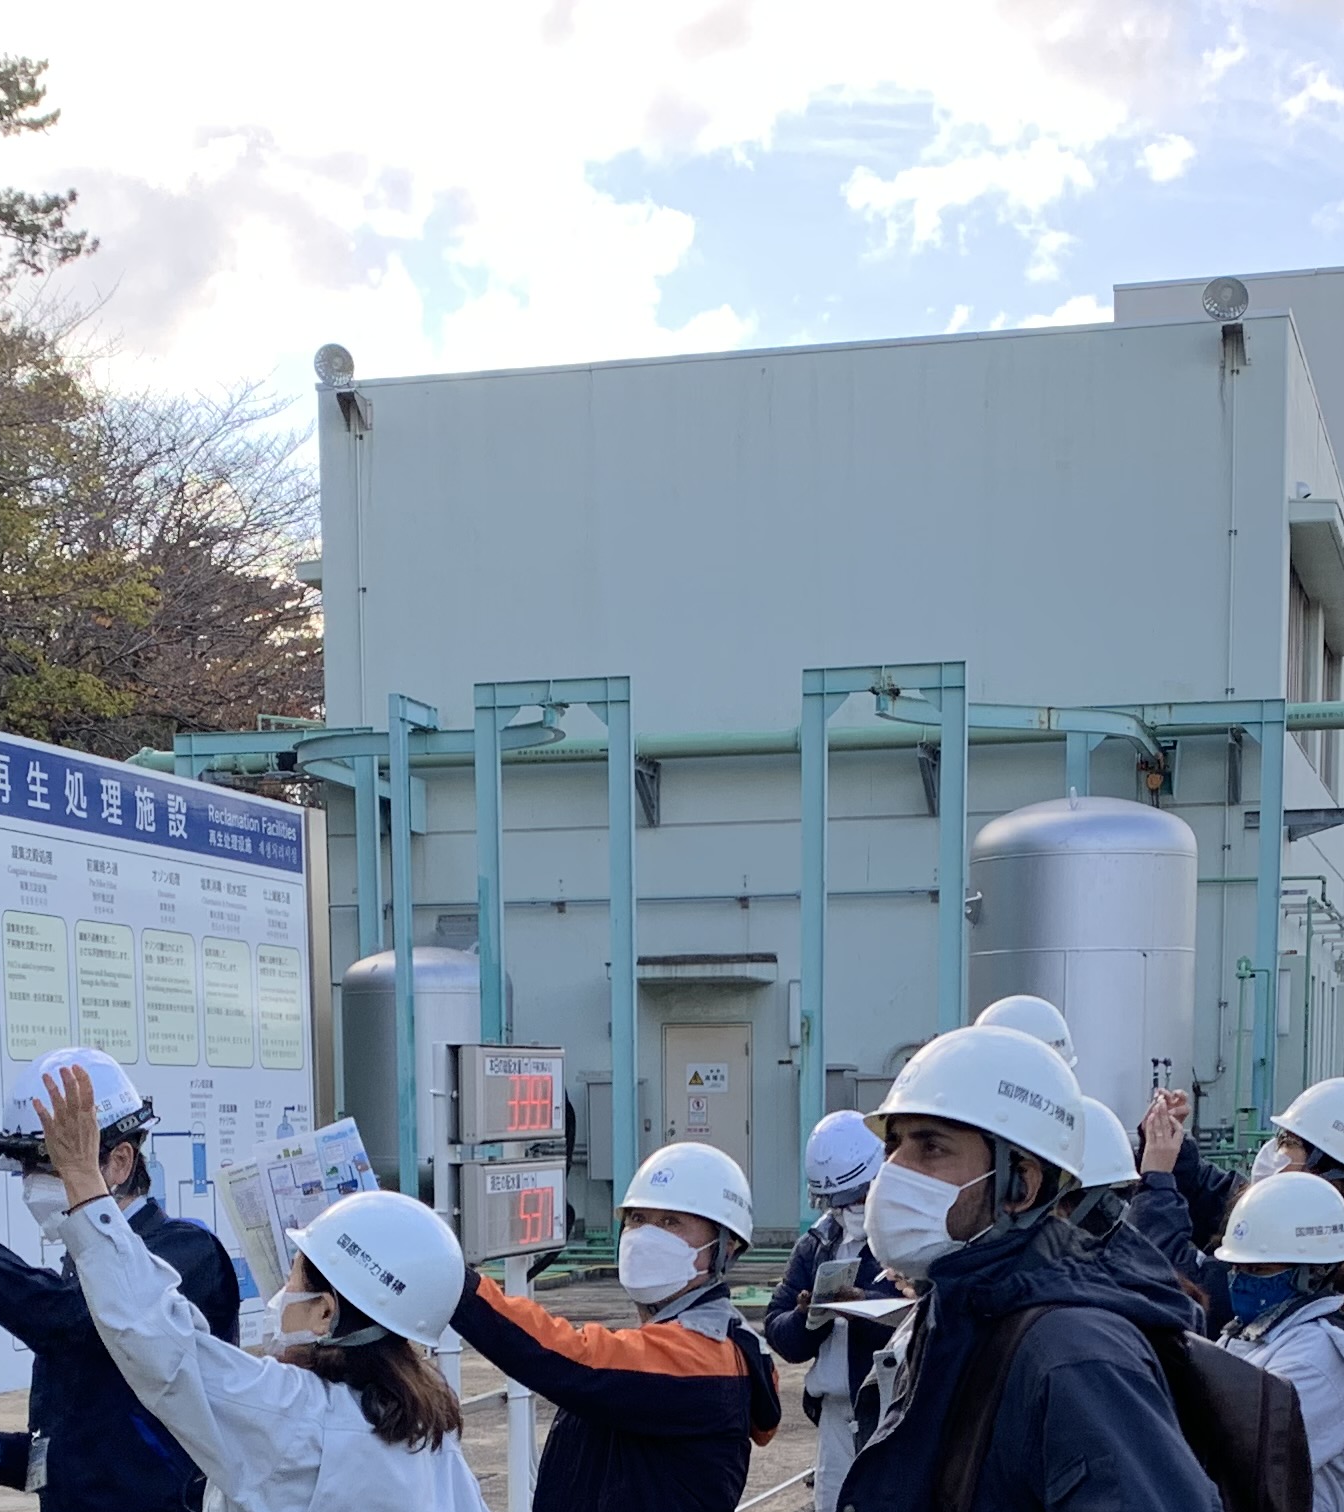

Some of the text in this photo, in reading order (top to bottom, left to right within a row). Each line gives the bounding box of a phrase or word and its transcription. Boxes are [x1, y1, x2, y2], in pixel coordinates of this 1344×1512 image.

[208, 804, 297, 842] Reclamation Facilities
[997, 1079, 1075, 1132] 国際協力機構
[1295, 1223, 1344, 1238] 国際協力機構
[336, 1232, 407, 1297] 国際協力機構
